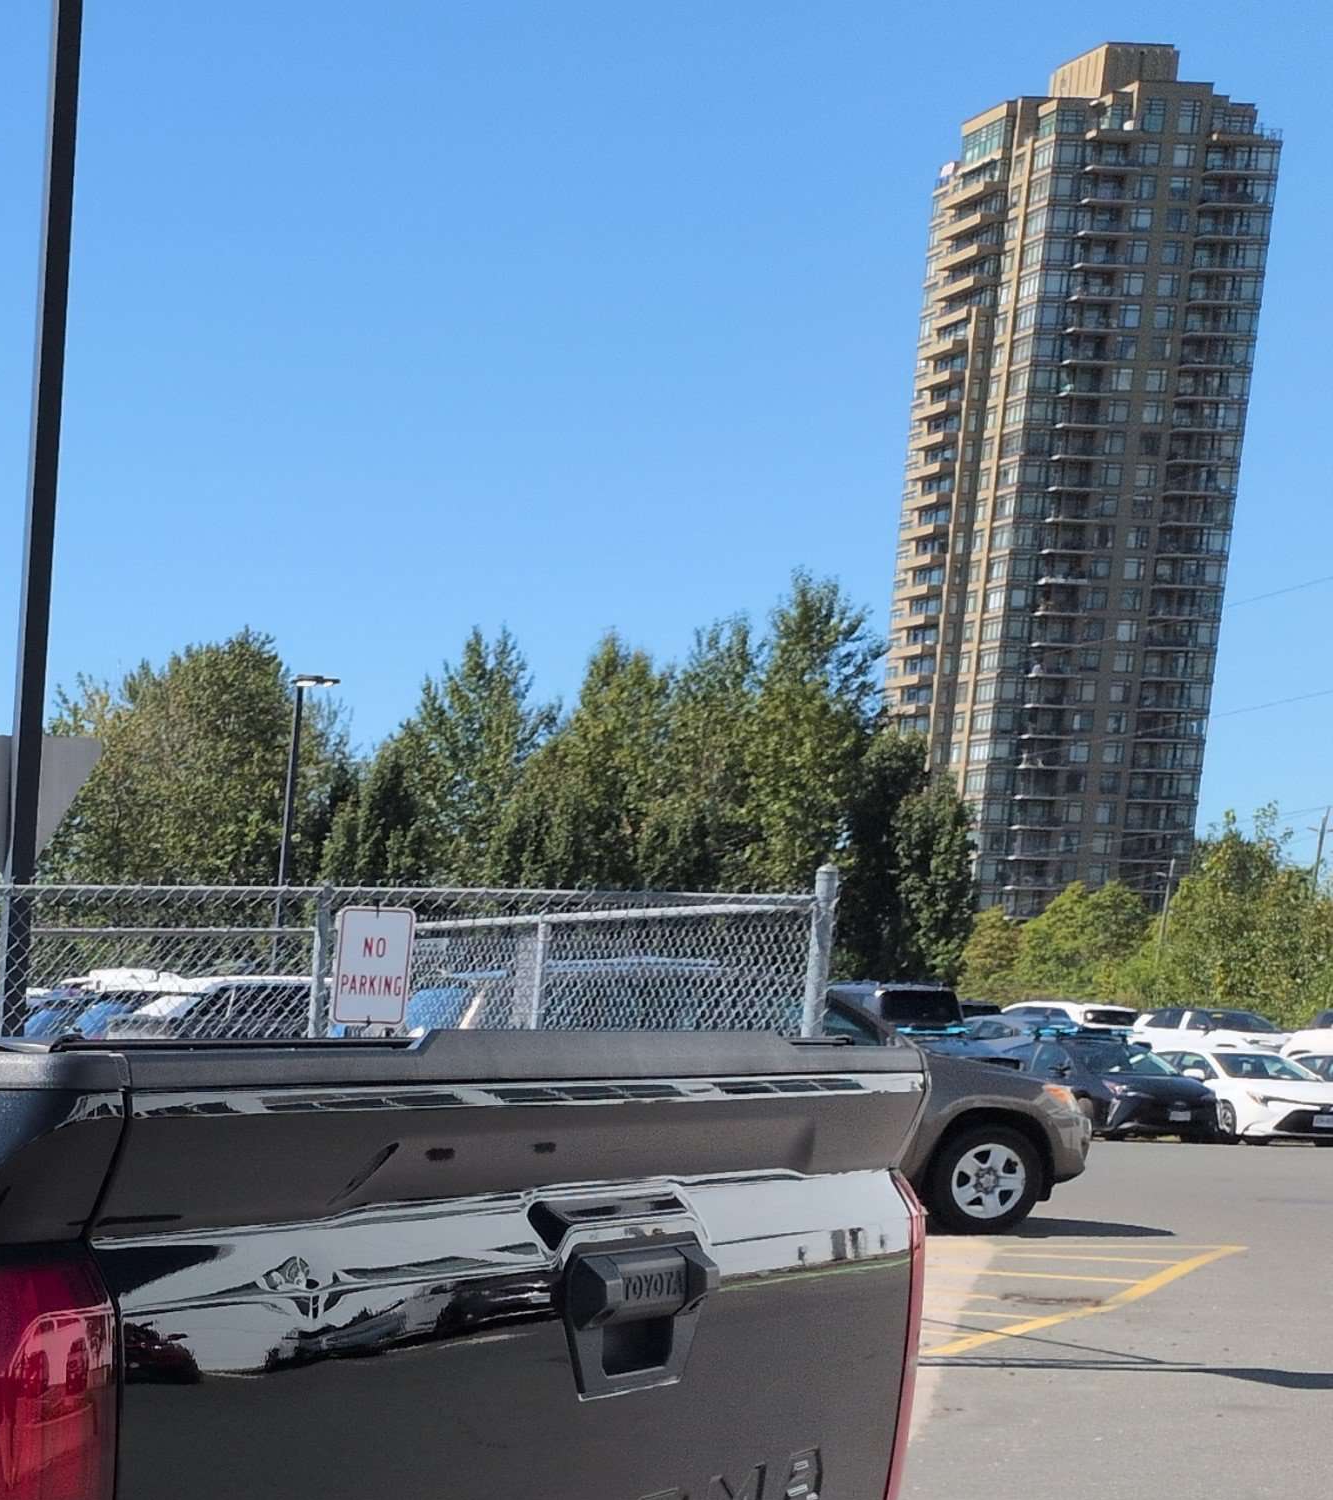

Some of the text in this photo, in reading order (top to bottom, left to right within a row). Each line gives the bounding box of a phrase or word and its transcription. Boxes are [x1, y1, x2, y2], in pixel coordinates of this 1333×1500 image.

[362, 937, 387, 958] NO
[339, 973, 402, 997] PARKING
[622, 1270, 685, 1301] TOYOTA
